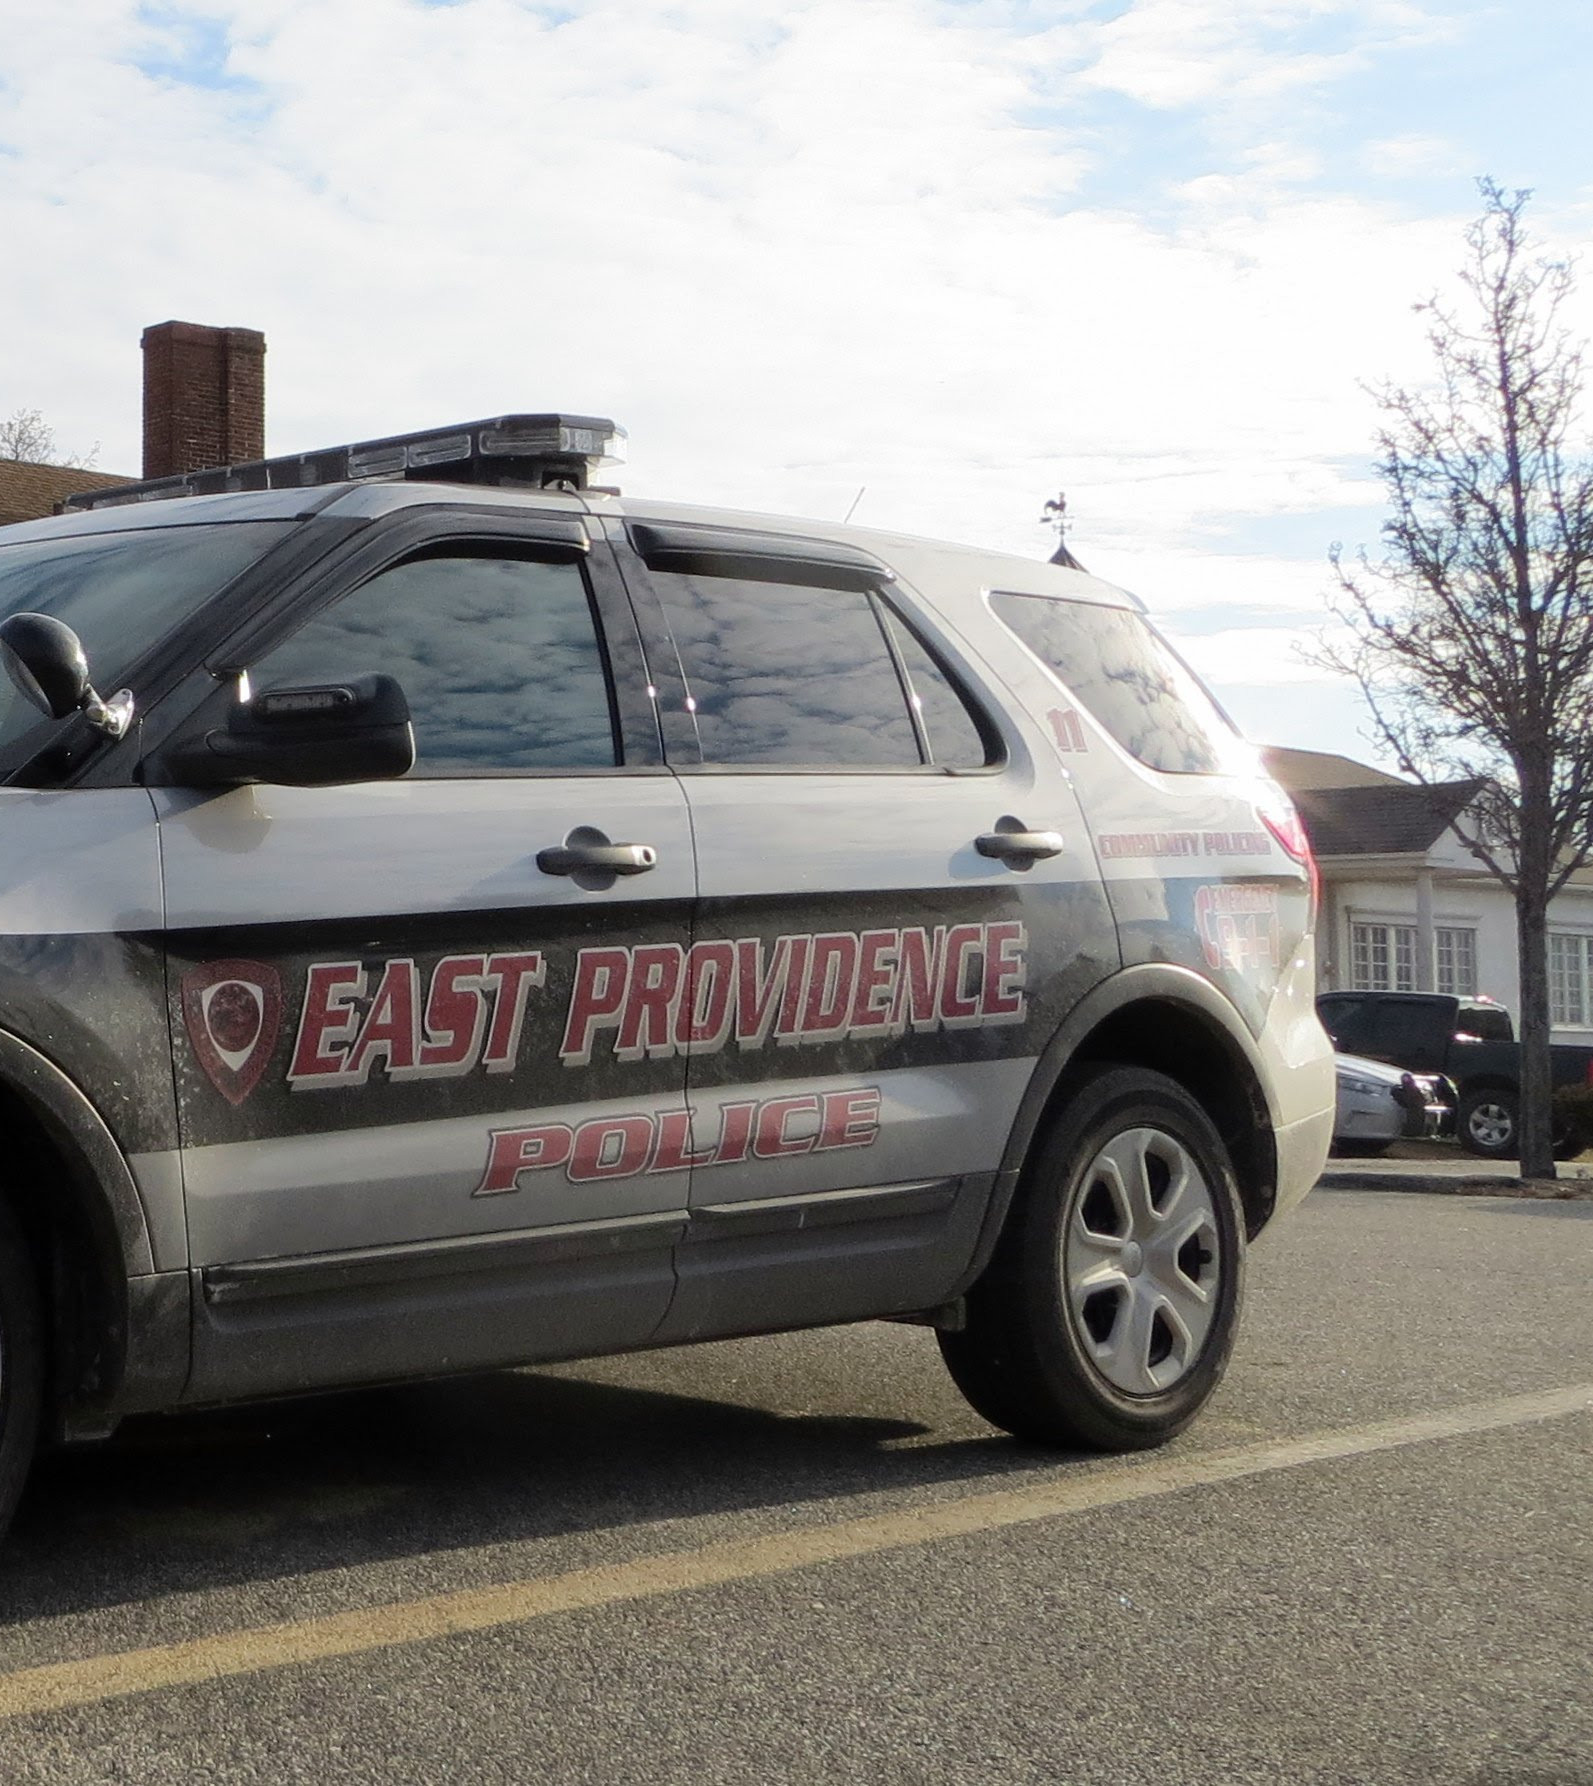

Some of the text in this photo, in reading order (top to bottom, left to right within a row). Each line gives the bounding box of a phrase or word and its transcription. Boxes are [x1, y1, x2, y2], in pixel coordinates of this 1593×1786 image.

[1047, 708, 1088, 752] 11
[1098, 832, 1271, 859] COMMUNITY POLICING
[288, 951, 546, 1092] EAST
[558, 921, 1027, 1066] PROVIDENCE
[472, 1087, 880, 1198] POLICE
